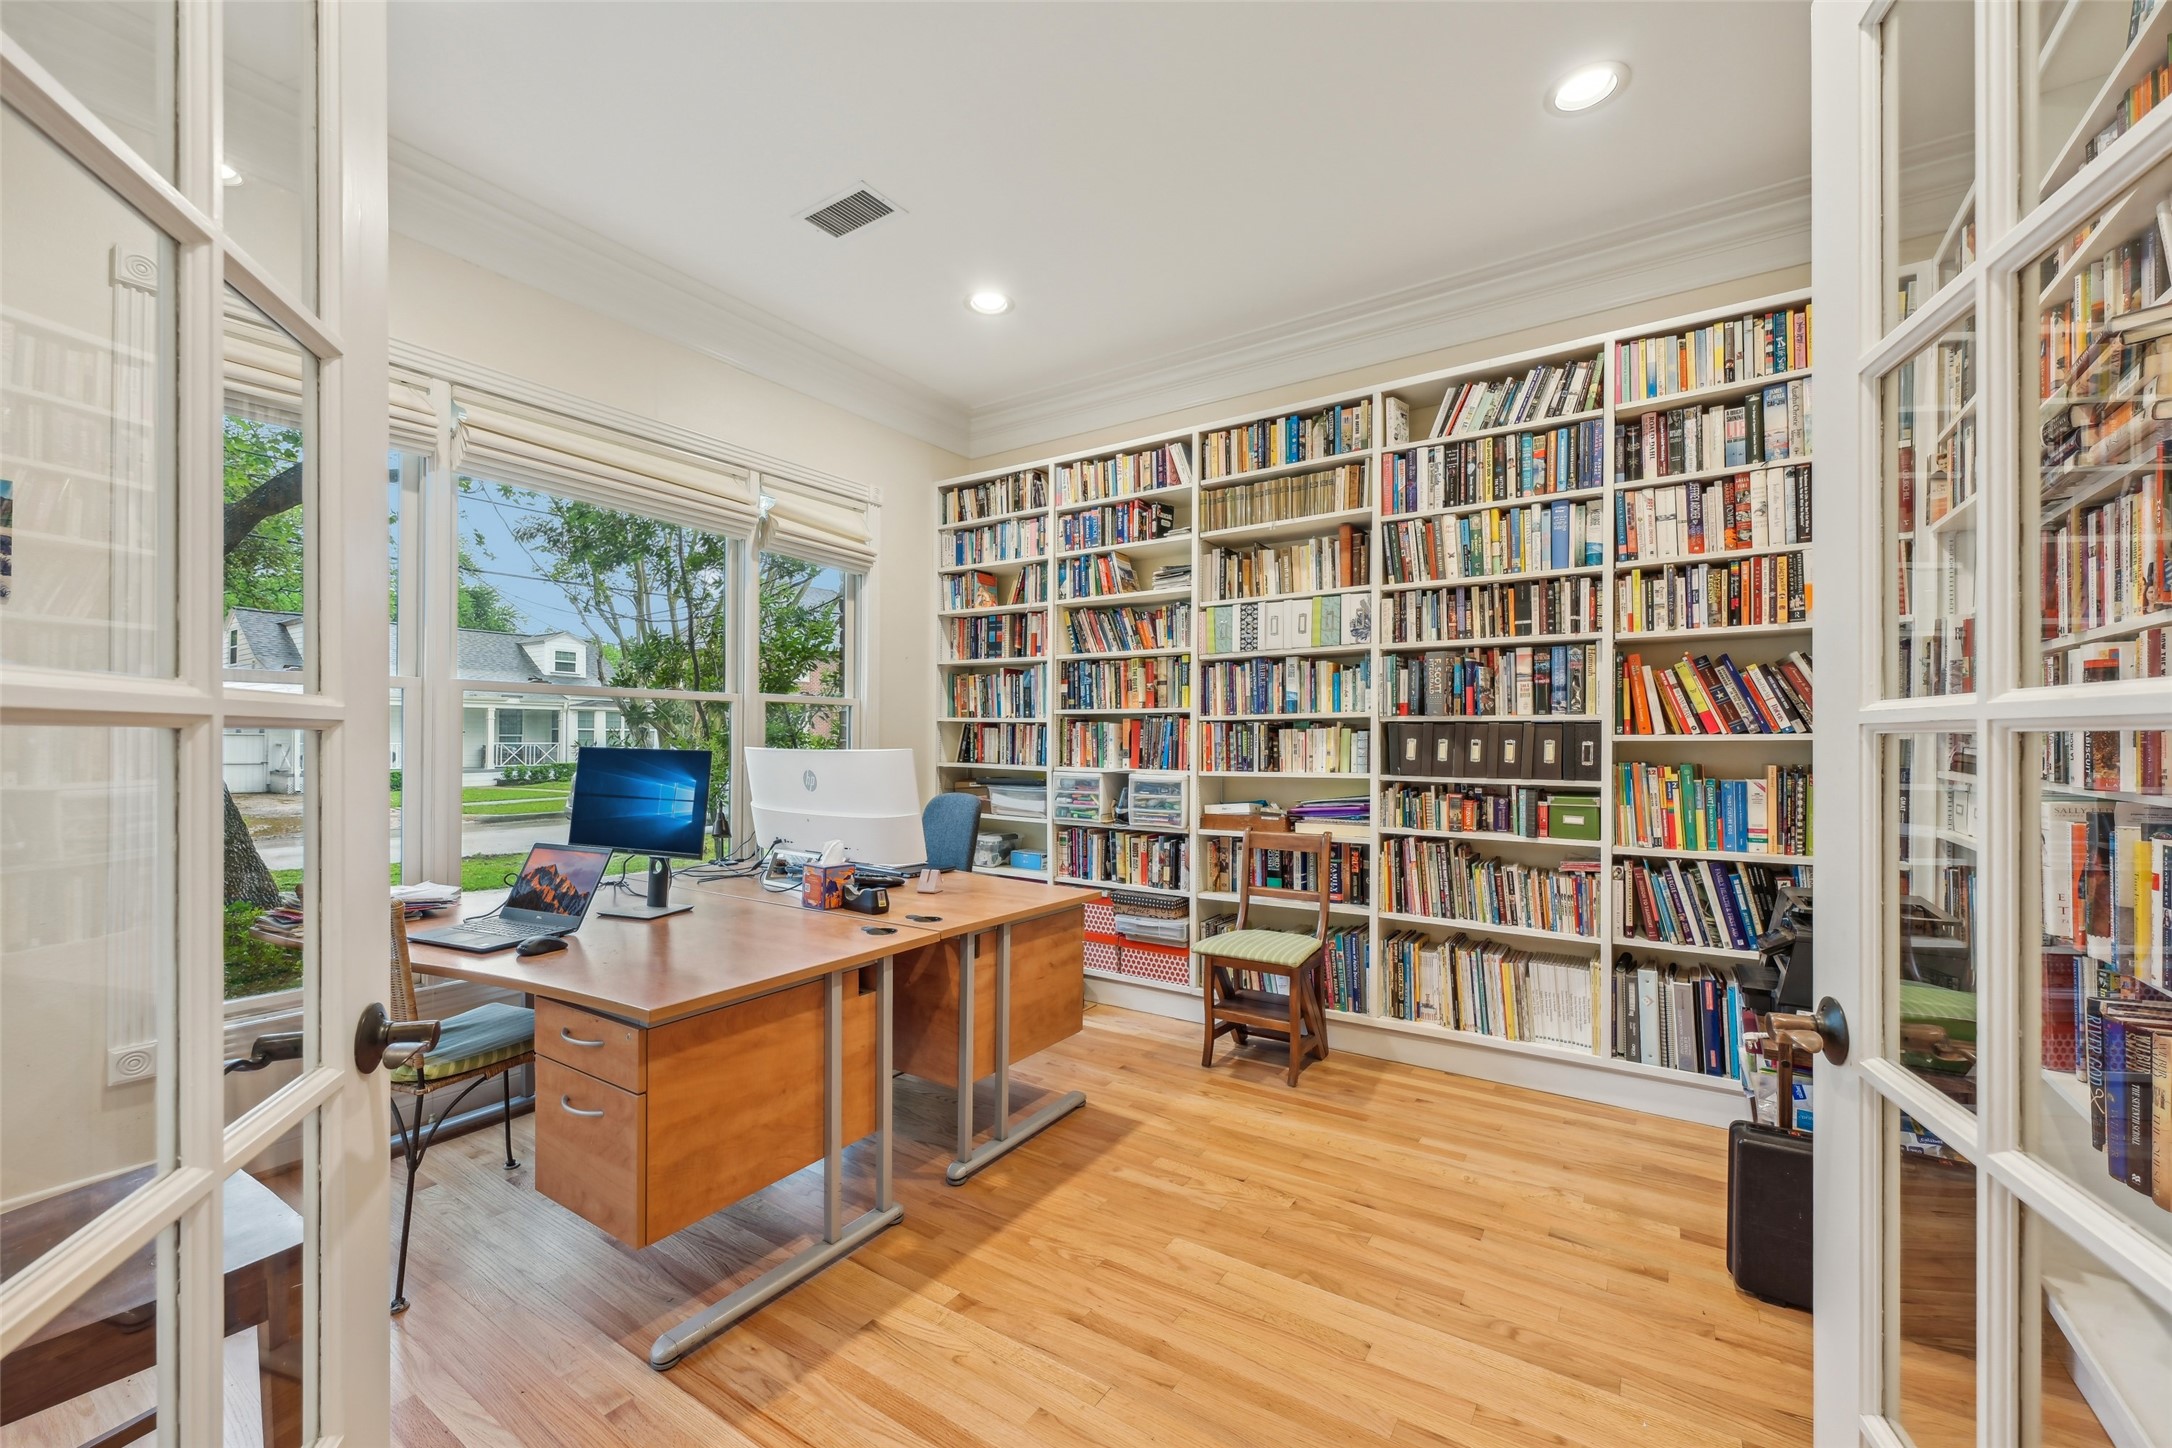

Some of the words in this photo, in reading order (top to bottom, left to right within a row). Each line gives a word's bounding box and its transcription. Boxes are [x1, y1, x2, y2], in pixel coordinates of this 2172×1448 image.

[1689, 483, 1699, 501] JEFFREY
[1690, 501, 1700, 520] ARCHER
[1434, 658, 1441, 666] F.
[1587, 648, 1596, 677] Hannah
[803, 769, 817, 792] hp
[2054, 807, 2086, 815] SALLY
[2088, 1015, 2102, 1054] RIVER
[2125, 1031, 2137, 1071] SMITH
[2136, 1035, 2151, 1074] WILBUR
[2158, 1041, 2167, 1079] WILBUR
[2089, 1057, 2103, 1086] GOD
[2131, 1084, 2140, 1097] THE
[2131, 1097, 2140, 1124] SEVENTH
[2110, 1107, 2120, 1158] WILBUR
[2131, 1124, 2140, 1146] SCROLL
